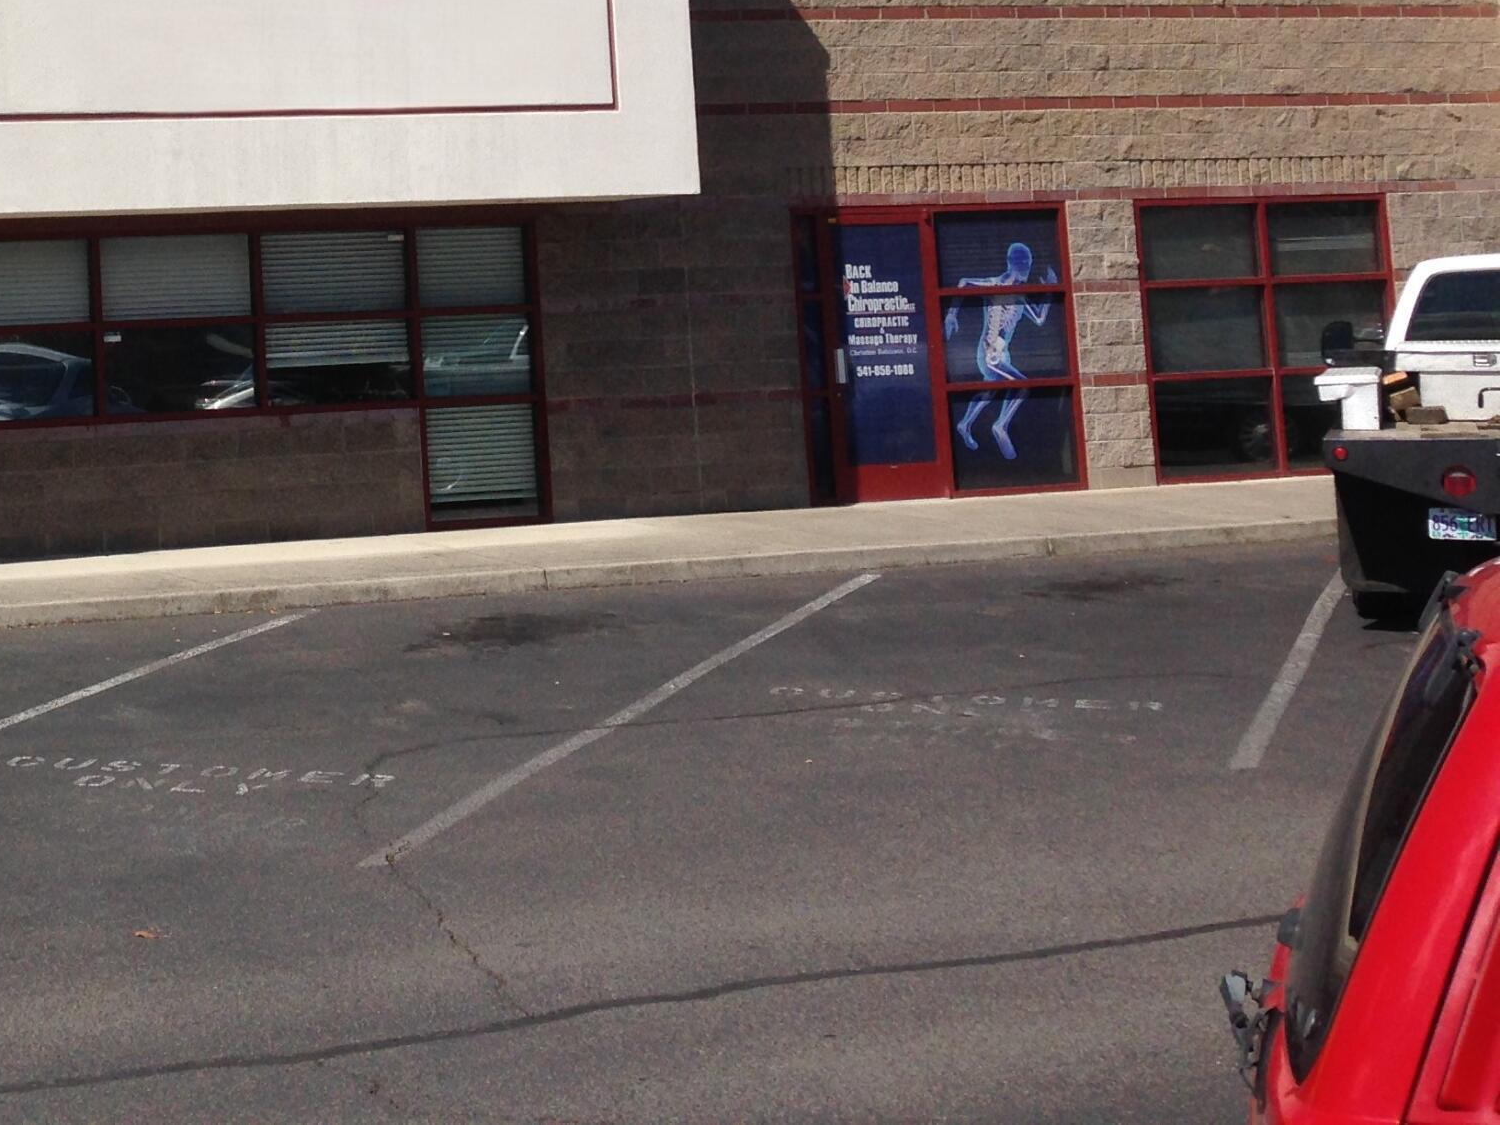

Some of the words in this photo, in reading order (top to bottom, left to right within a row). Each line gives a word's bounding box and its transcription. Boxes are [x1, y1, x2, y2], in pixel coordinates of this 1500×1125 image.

[845, 264, 872, 279] BACK
[861, 280, 899, 293] Balance
[847, 295, 908, 313] Chiropractic
[854, 316, 909, 328] CHIROPRACTIC
[848, 335, 884, 346] Massage
[885, 333, 918, 344] Therapy
[1433, 515, 1458, 531] 856
[6, 756, 397, 787] CUSTOMER
[73, 774, 269, 796] ONLY
